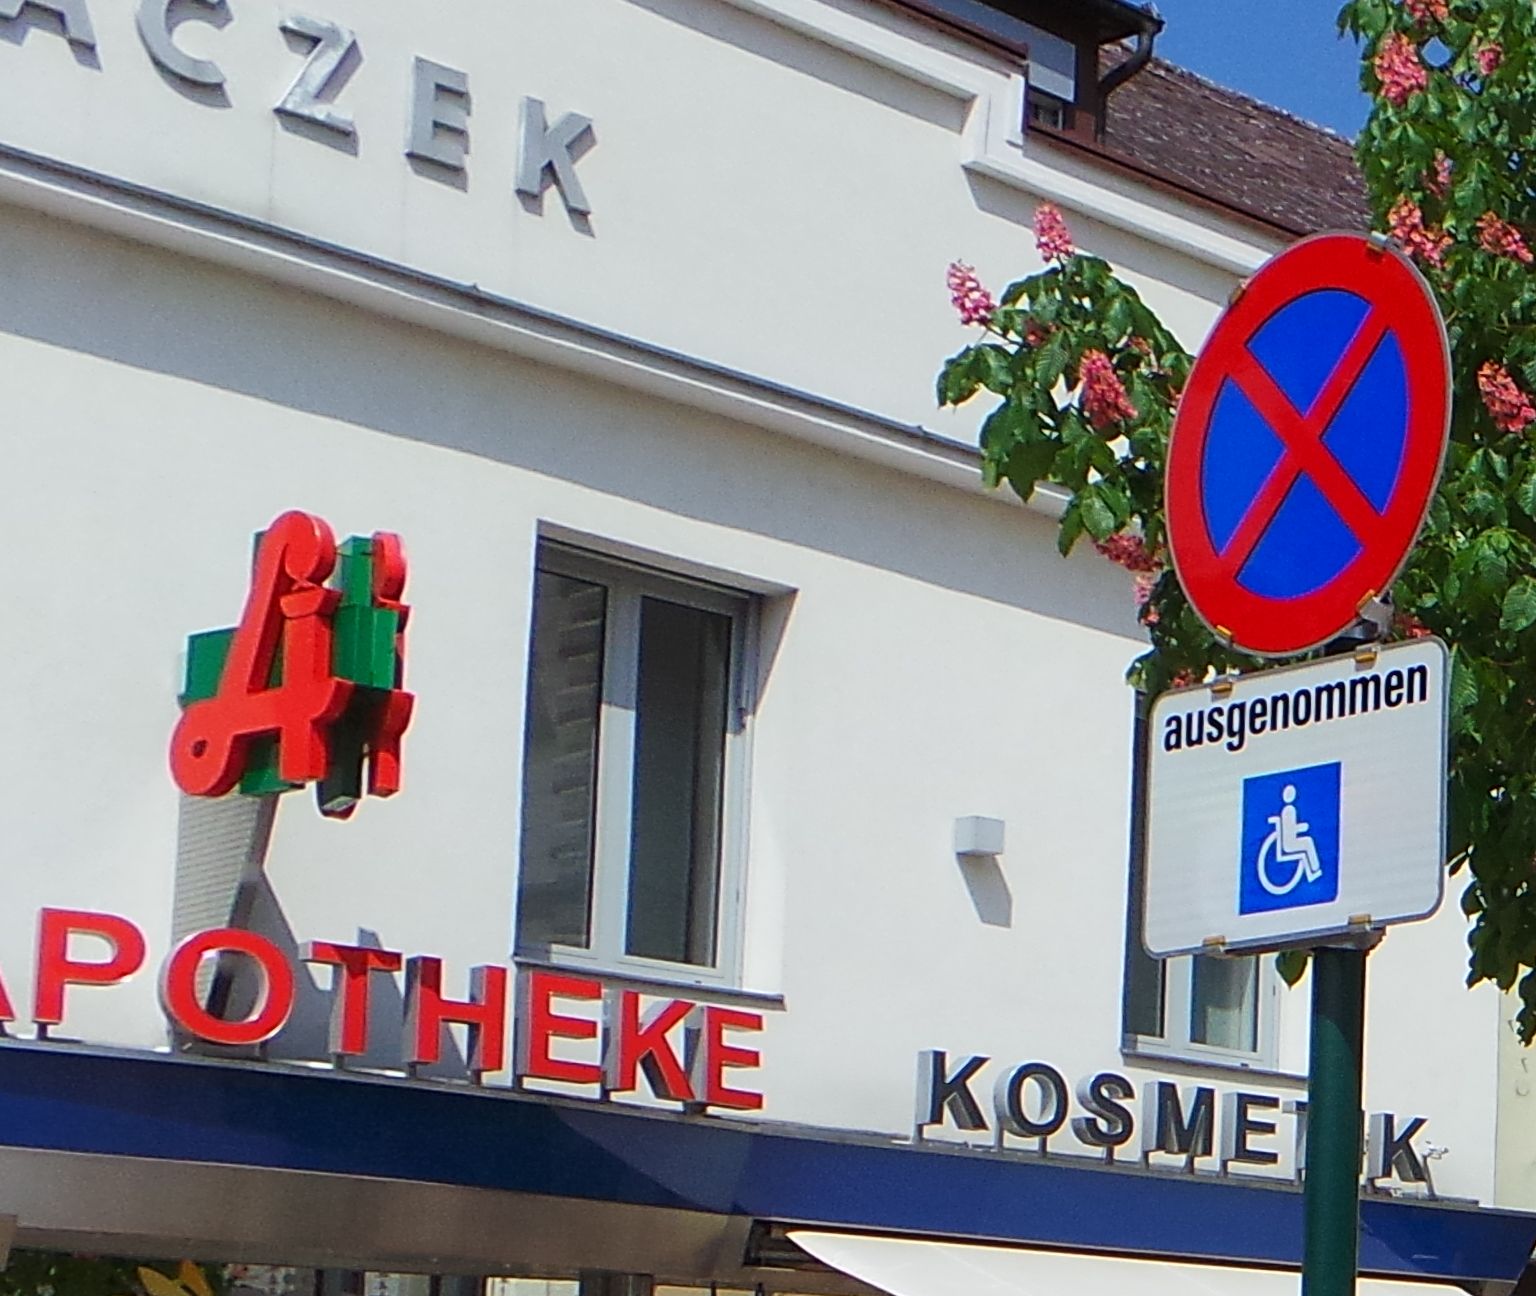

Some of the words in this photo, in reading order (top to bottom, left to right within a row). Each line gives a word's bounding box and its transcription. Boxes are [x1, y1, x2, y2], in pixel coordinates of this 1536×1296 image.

[1164, 664, 1429, 752] ausgenommen
[0, 906, 765, 1111] POTHEKE
[915, 1050, 1427, 1184] KOSMEK
